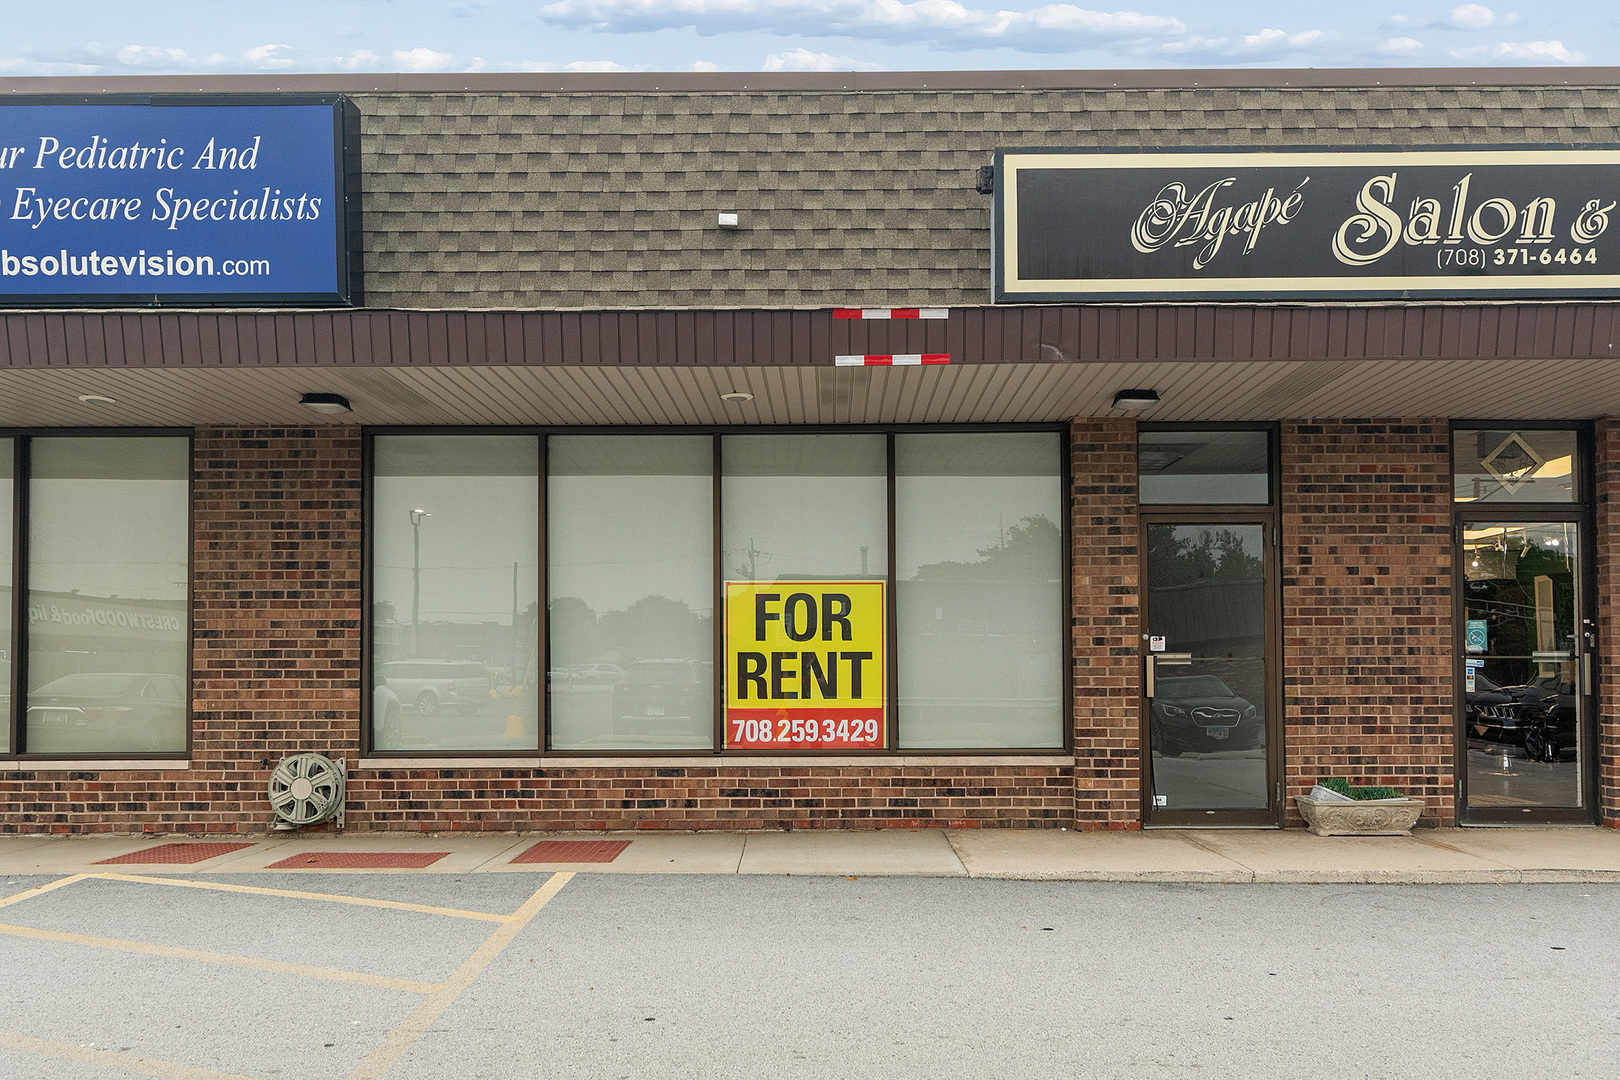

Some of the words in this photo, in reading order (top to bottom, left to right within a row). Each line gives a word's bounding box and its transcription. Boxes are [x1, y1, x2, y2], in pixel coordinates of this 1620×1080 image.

[33, 135, 184, 170] Pediatric
[192, 135, 261, 170] And
[10, 187, 142, 229] Eyecare
[152, 186, 322, 230] Specialists
[1130, 176, 1311, 270] Agapé
[1332, 172, 1556, 266] Salon
[1571, 198, 1617, 244] &
[1, 249, 270, 276] bsolutevision.com
[1437, 248, 1486, 269] (708)
[1494, 247, 1598, 265] 371-6464
[755, 592, 853, 642] FOR
[737, 651, 873, 700] RENT
[732, 719, 878, 742] 708.259.3429
